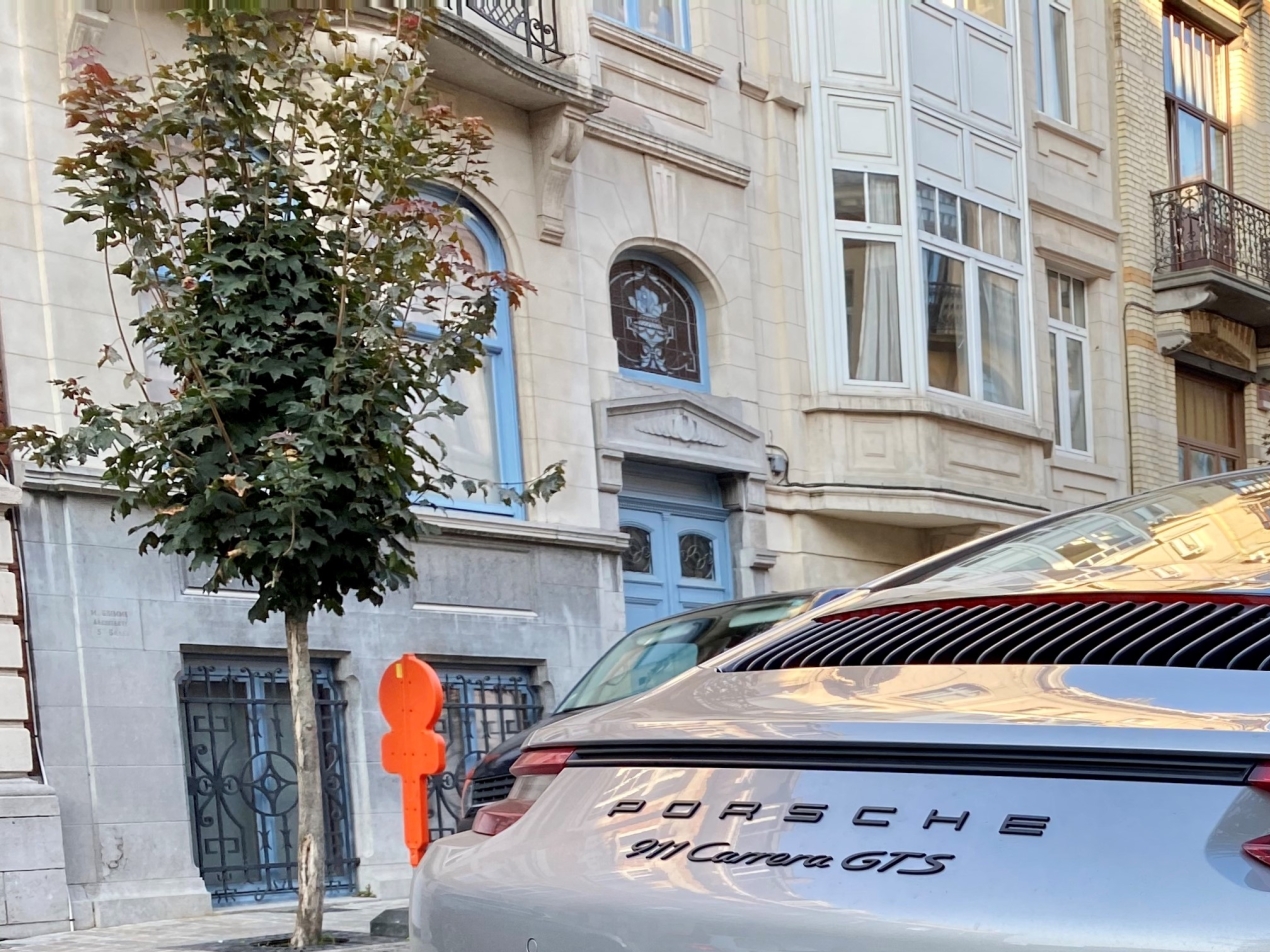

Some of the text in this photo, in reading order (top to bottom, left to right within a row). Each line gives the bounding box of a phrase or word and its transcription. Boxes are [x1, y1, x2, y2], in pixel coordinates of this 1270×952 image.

[607, 800, 1050, 836] PORSCHE
[626, 838, 956, 875] 911 Carrera GTS
